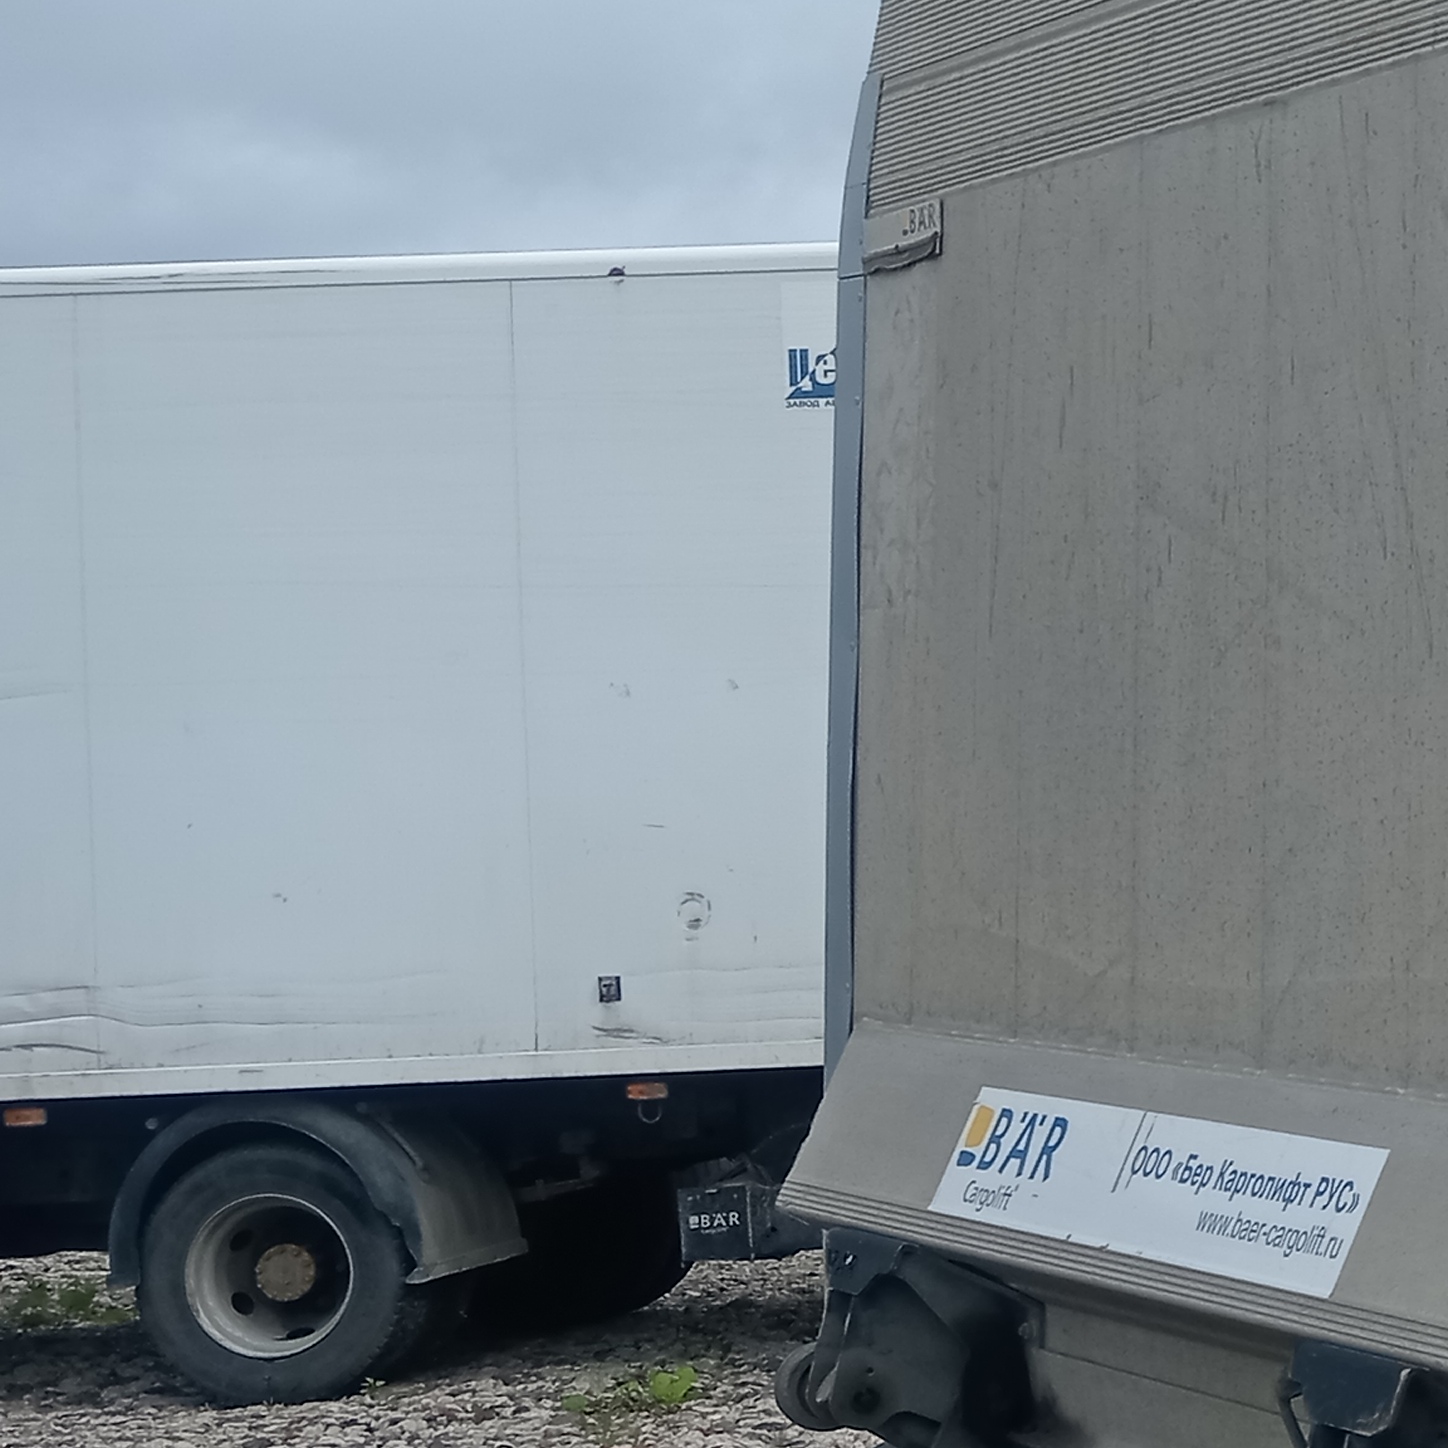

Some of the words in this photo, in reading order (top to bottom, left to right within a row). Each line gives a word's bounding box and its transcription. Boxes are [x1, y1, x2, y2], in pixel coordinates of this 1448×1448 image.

[976, 1107, 1069, 1183] BÄR
[963, 1180, 1014, 1212] Cargolift
[1131, 1145, 1173, 1180] ООО
[1171, 1153, 1214, 1195] «Бер
[1212, 1159, 1313, 1212] Карголифт
[1309, 1176, 1361, 1214] РУС»
[700, 1211, 740, 1228] BÄR
[1195, 1210, 1344, 1260] www.baer-cargolift.ru
